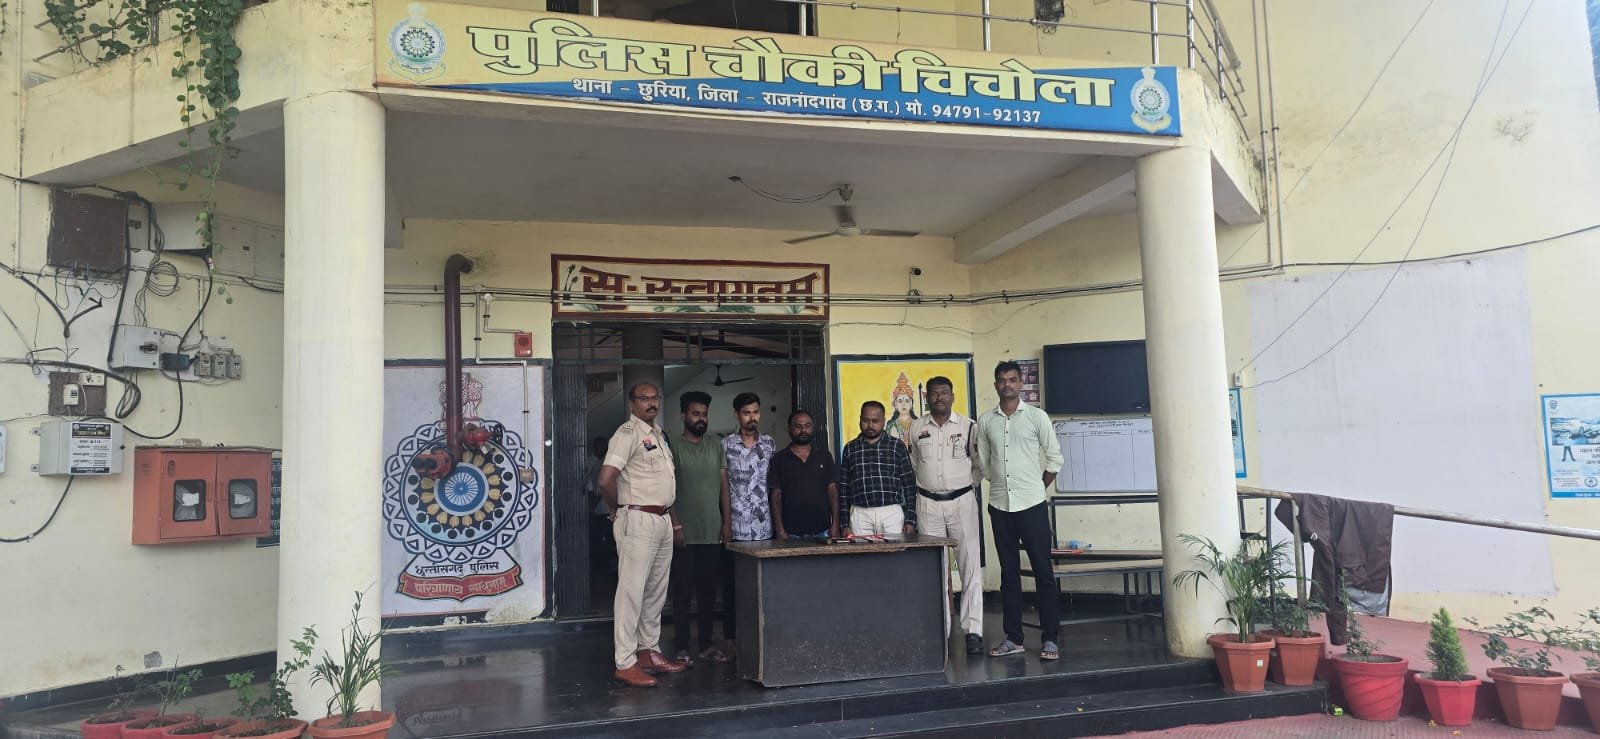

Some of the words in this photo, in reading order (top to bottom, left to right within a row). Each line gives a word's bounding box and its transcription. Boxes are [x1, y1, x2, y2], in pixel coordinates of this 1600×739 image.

[466, 17, 696, 76] पुलिस
[702, 36, 889, 91] चौकी
[891, 49, 1116, 108] चिचोला
[572, 77, 613, 94] थाना
[638, 80, 690, 101] छुरिया,
[697, 83, 739, 103] जिला
[761, 91, 847, 110] राजनांदगांव
[852, 96, 900, 115] (छ.ग.)
[904, 99, 927, 116] मो.
[931, 104, 1041, 123] 94791-92137
[468, 560, 500, 574] पुलिस
